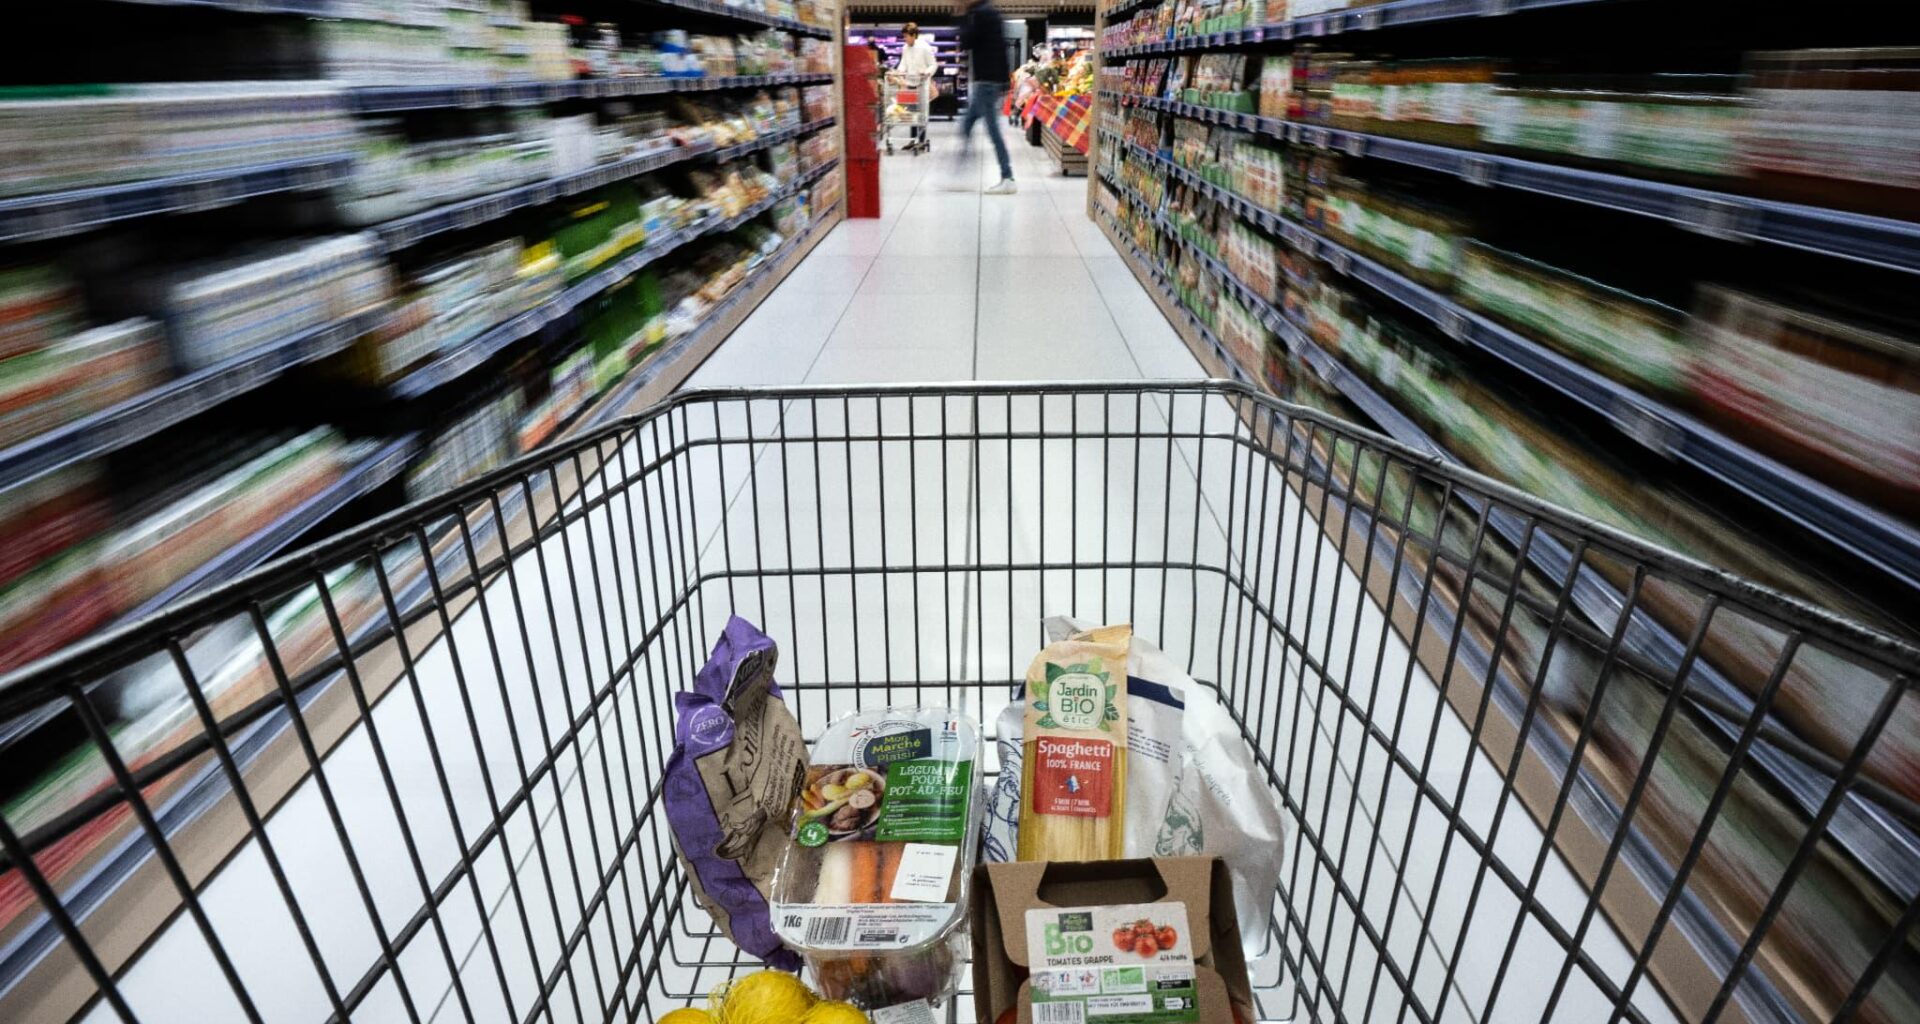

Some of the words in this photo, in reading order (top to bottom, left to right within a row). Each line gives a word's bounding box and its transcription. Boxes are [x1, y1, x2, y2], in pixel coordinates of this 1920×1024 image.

[1056, 682, 1097, 697] Jardin
[1061, 696, 1095, 714] BiO
[872, 738, 921, 753] Marché
[884, 735, 908, 744] Mon
[1038, 740, 1111, 758] Spaghetti
[877, 751, 917, 763] Plaisir
[1046, 759, 1067, 769] 100%
[1069, 760, 1102, 771] FRANCE
[910, 775, 947, 786] POUR
[888, 785, 964, 796] POT-AU-FEU
[807, 829, 818, 841] 4
[783, 915, 802, 929] 1KG
[1046, 956, 1082, 966] TOMATES
[1084, 955, 1114, 965] GRAPPE
